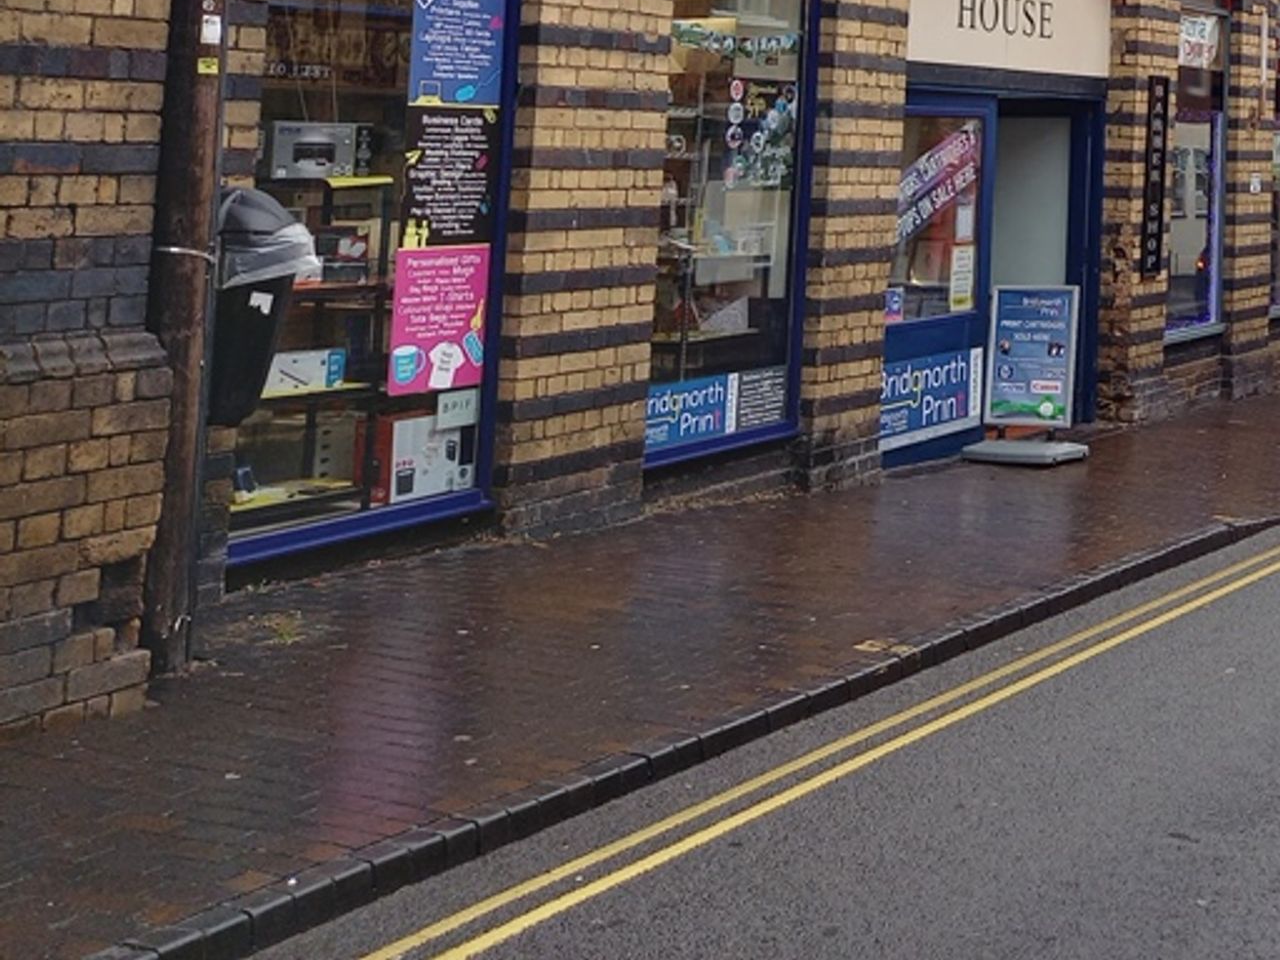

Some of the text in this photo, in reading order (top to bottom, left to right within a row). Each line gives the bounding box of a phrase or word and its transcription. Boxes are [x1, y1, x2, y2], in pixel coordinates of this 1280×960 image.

[931, 179, 957, 209] SALE
[1147, 205, 1159, 268] SHOP
[647, 381, 724, 424] ridgnorth
[922, 391, 967, 426] Print
[680, 409, 721, 437] Print
